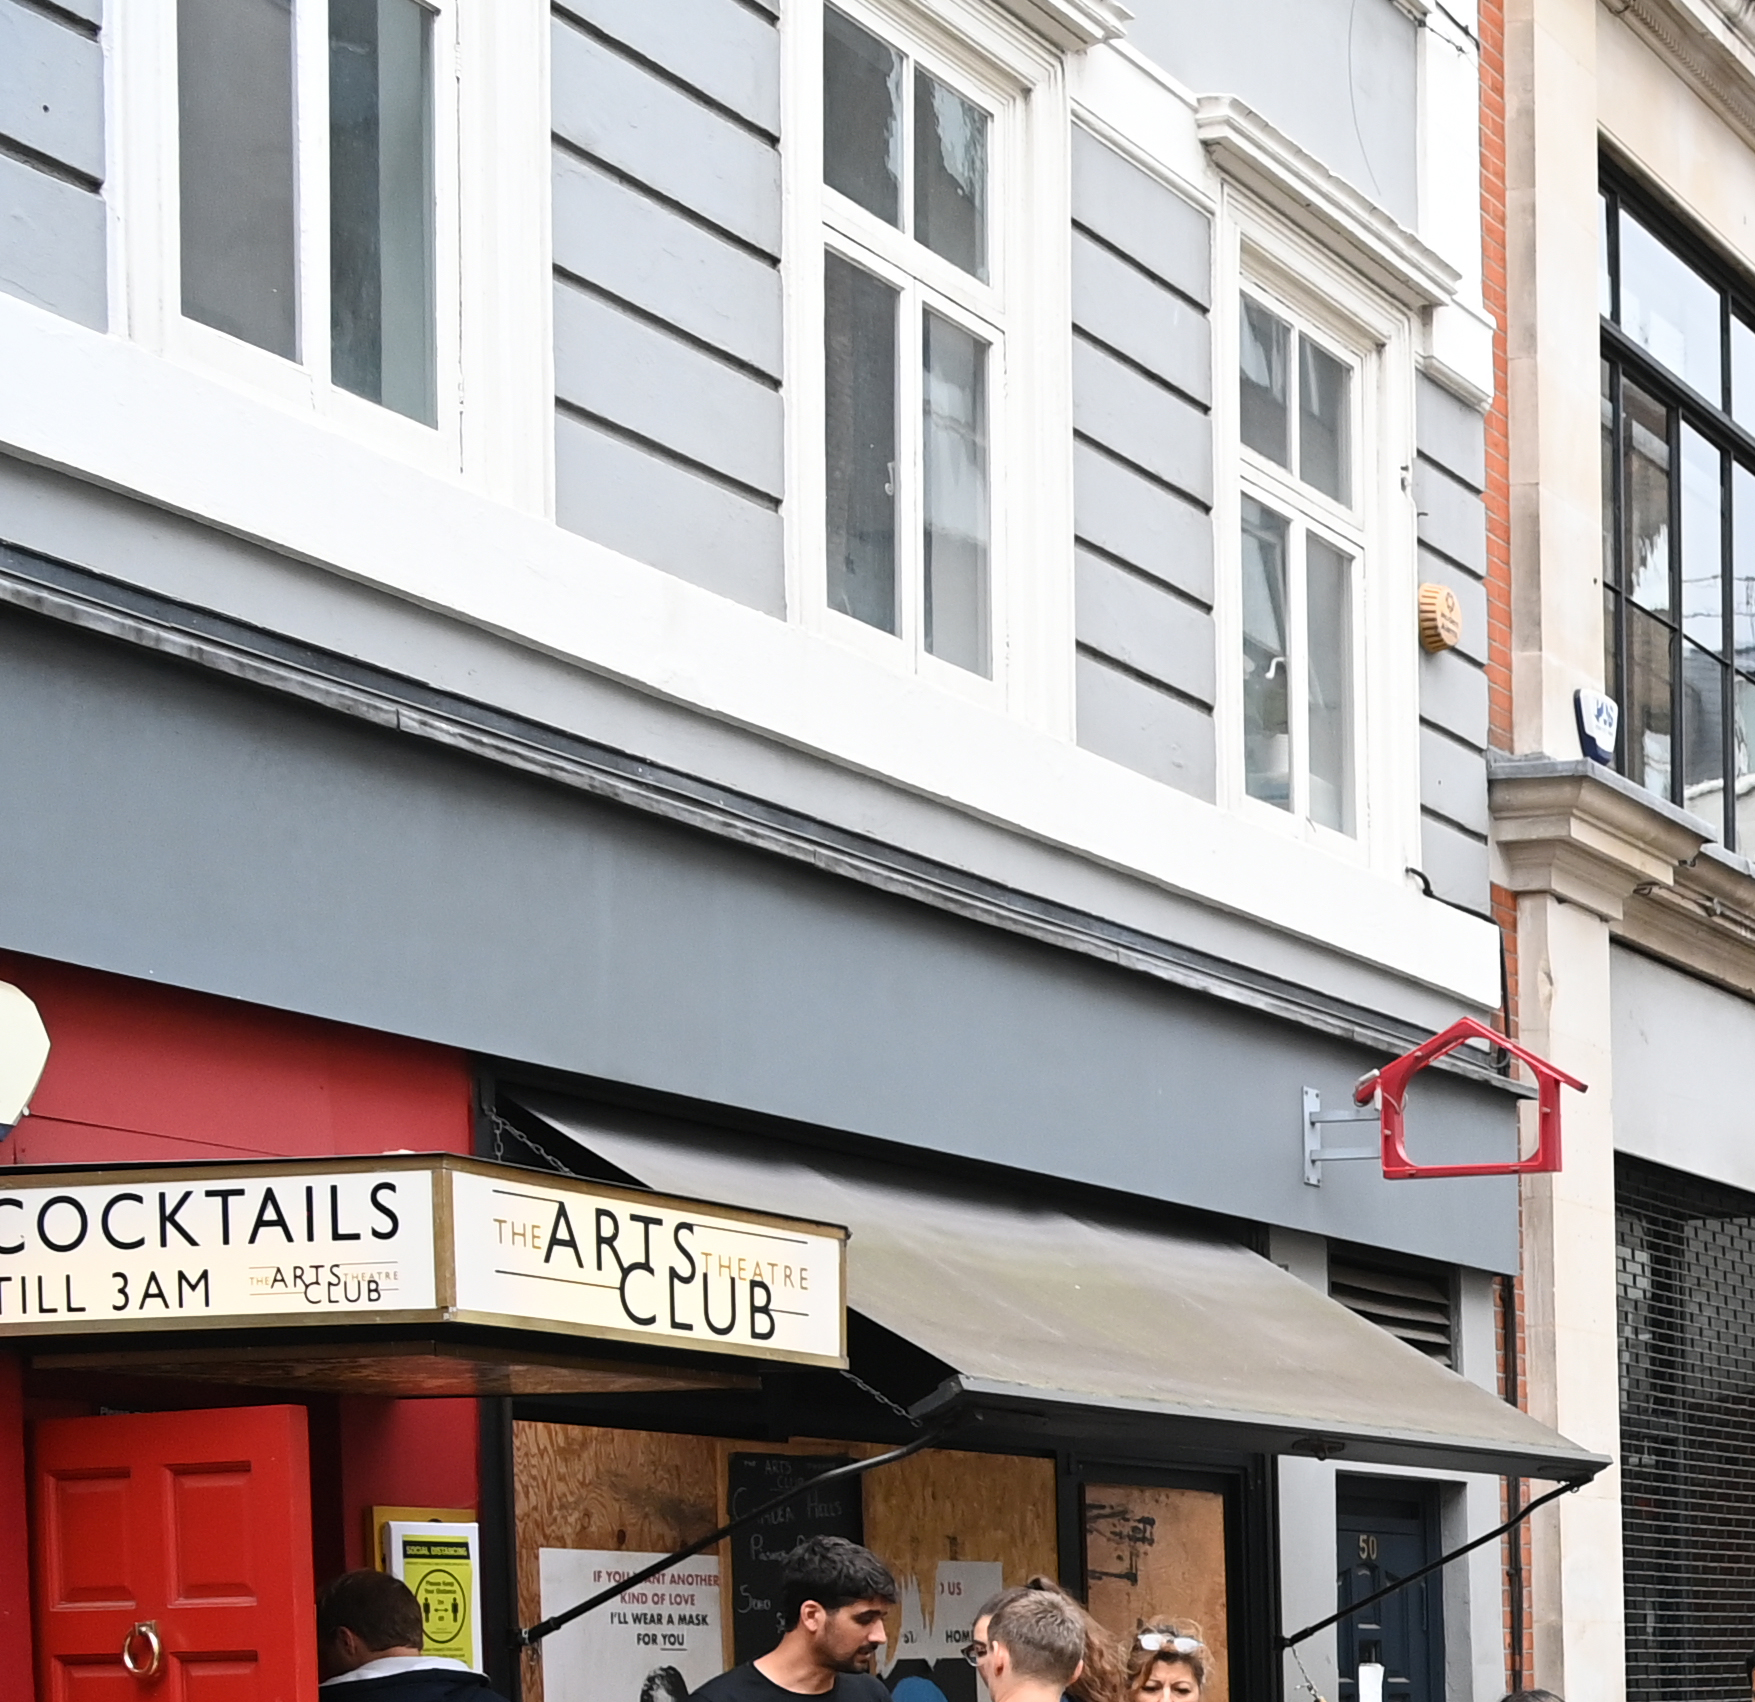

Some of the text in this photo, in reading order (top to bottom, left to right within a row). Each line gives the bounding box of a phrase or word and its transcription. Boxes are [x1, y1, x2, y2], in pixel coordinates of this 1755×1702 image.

[493, 1200, 810, 1291] THE ARTS THEATRE
[270, 1264, 341, 1289] ARTS
[111, 1268, 211, 1312] 3AM
[304, 1279, 381, 1305] CLUB
[619, 1261, 776, 1341] CLUB
[1358, 1534, 1378, 1560] 50
[593, 1570, 602, 1583] IF
[669, 1573, 721, 1587] ANOTHER
[947, 1581, 962, 1596] US
[620, 1592, 696, 1607] KIND OF LOVE
[610, 1611, 710, 1626] I'LL WEAR A MASK
[636, 1632, 685, 1646] FOR YOU
[945, 1629, 974, 1644] HOM
